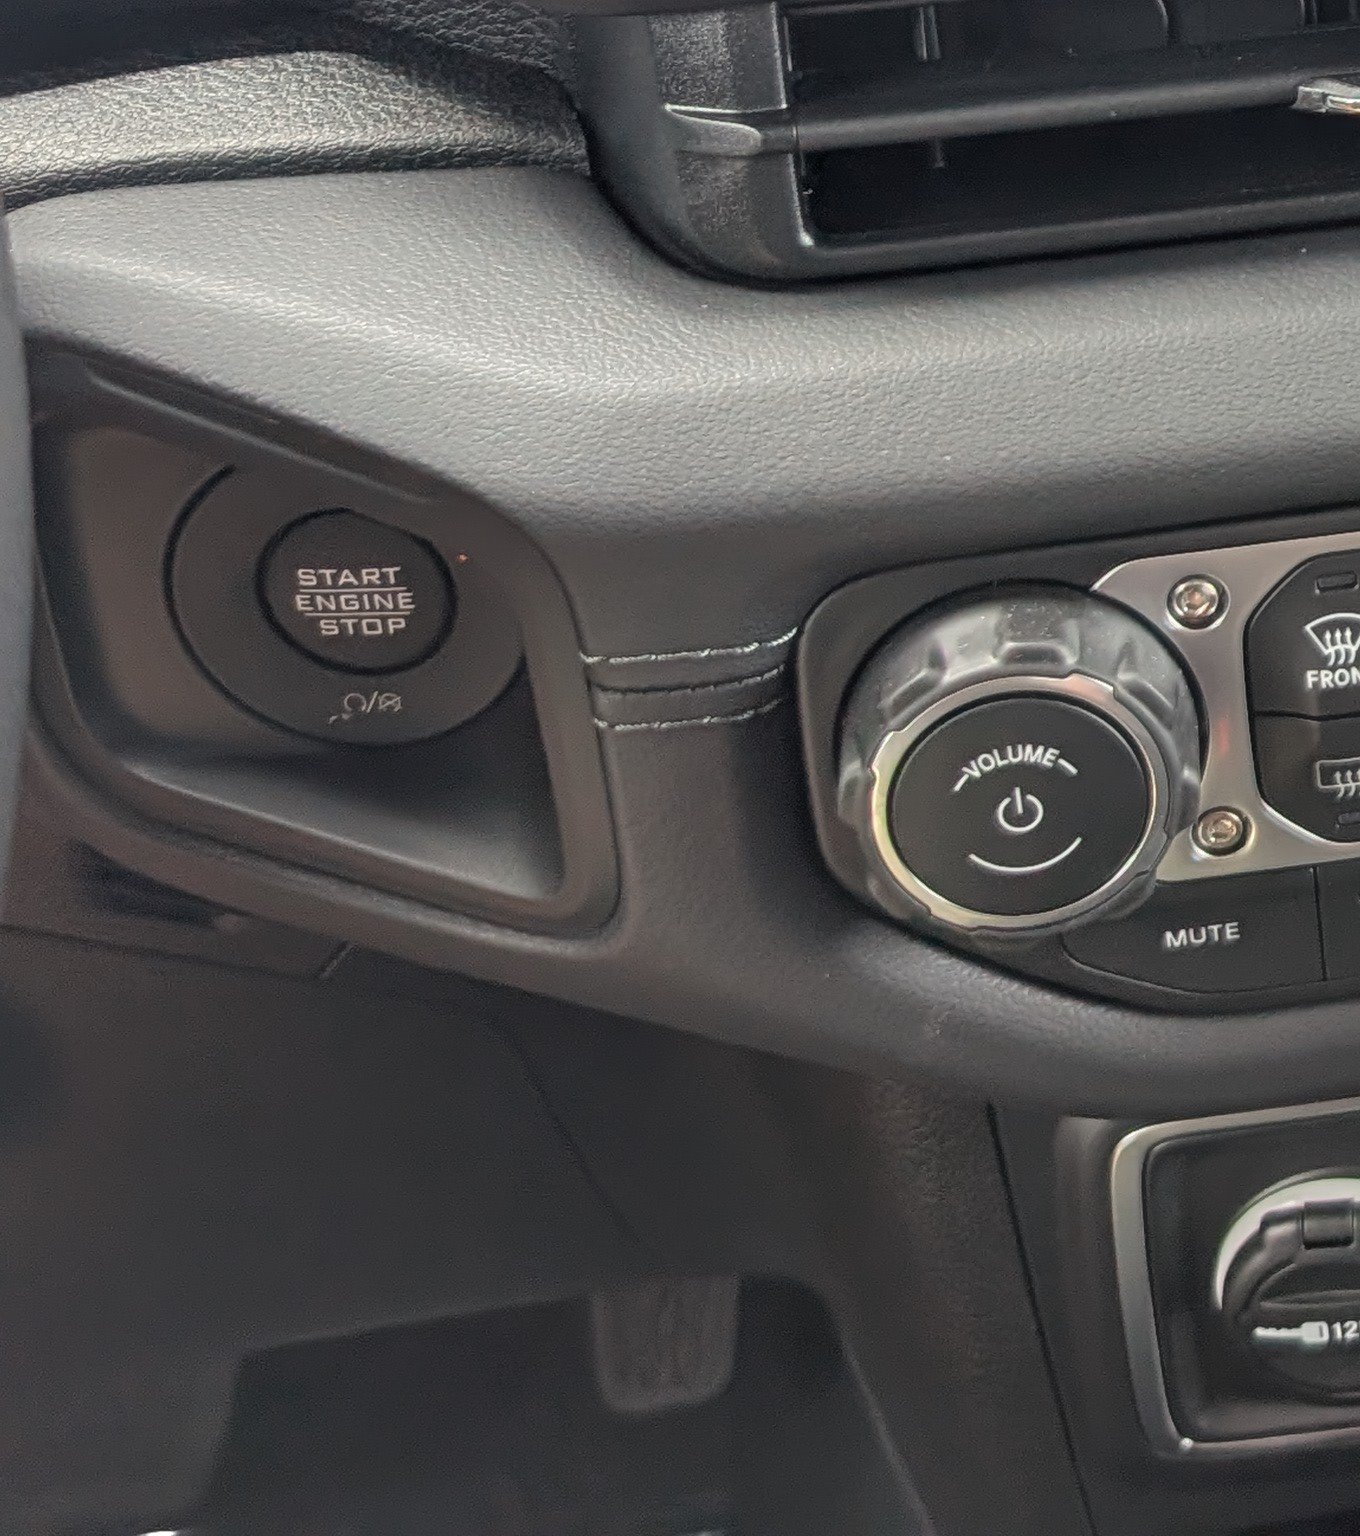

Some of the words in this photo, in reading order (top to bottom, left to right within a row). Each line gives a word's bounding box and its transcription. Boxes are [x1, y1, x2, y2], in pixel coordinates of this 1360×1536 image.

[297, 567, 400, 586] START
[295, 592, 416, 611] ENGINE
[320, 617, 406, 636] STOP
[962, 743, 1060, 779] VOLUME
[1164, 921, 1241, 950] MUTE
